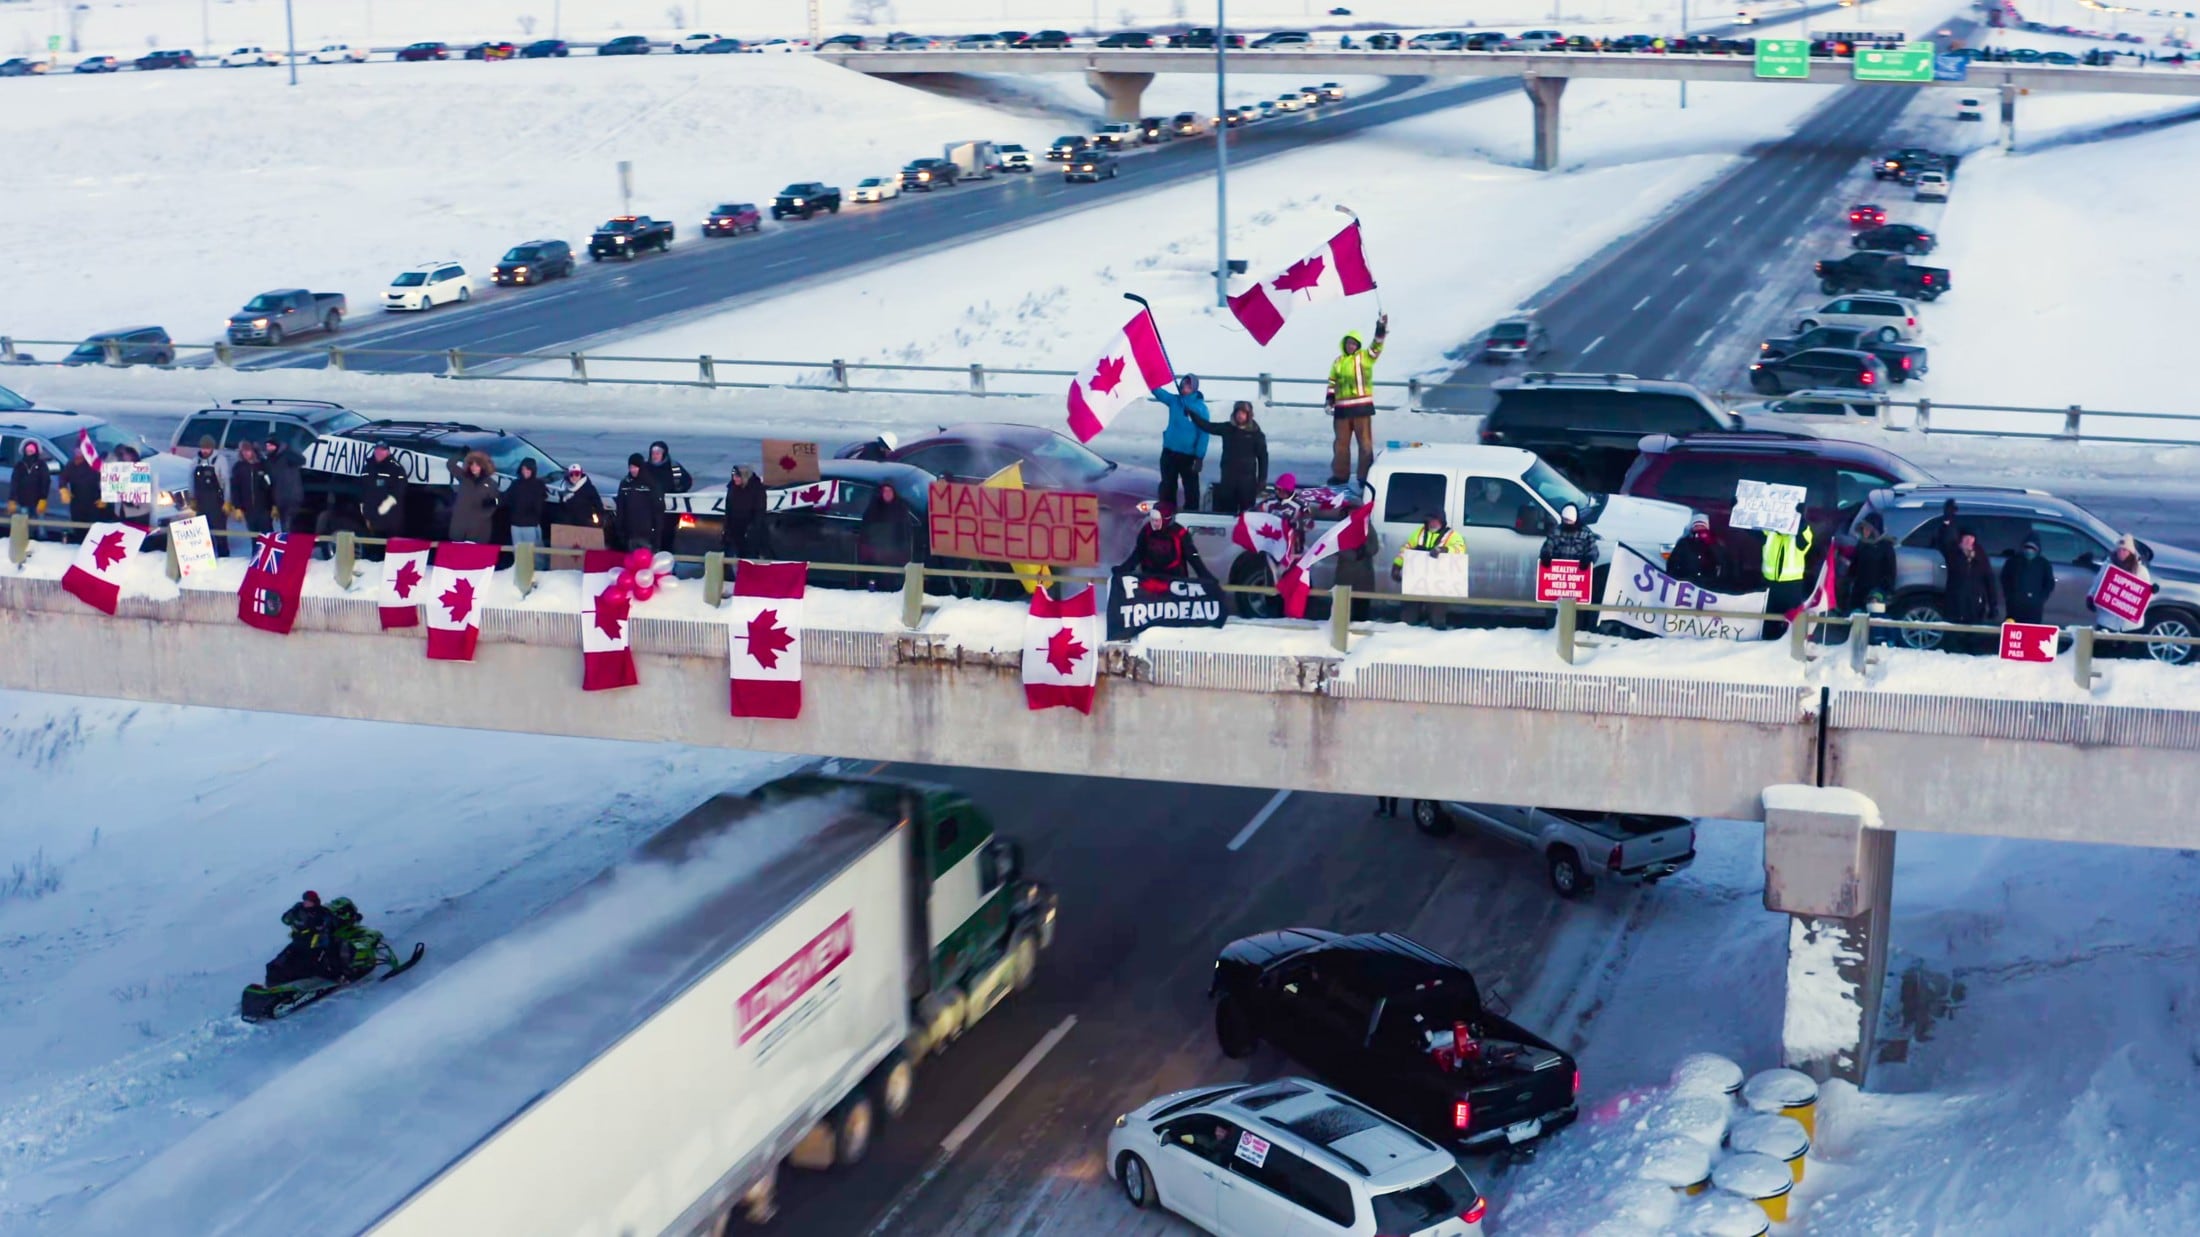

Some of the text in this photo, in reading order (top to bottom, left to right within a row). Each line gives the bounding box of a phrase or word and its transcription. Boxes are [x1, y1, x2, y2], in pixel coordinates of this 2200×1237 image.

[310, 439, 375, 475] THANK
[929, 484, 1097, 526] MANDATE
[174, 526, 203, 540] THANK
[930, 513, 1099, 562] FREEDOM
[1543, 573, 1585, 582] PEOPLE DON'T
[1551, 565, 1578, 573] HEALTHY
[1551, 581, 1577, 590] NEED TO
[1633, 562, 1719, 611] STEP
[2112, 574, 2145, 595] SUPPORT
[1544, 589, 1583, 598] QUARANTINE
[2107, 582, 2142, 606] THE RIGHT
[2102, 592, 2139, 616] TO CHOOSE
[1120, 601, 1220, 628] TRUDEAU
[2009, 630, 2022, 640] NO
[2009, 641, 2021, 649] VAX
[2007, 650, 2024, 658] PASS
